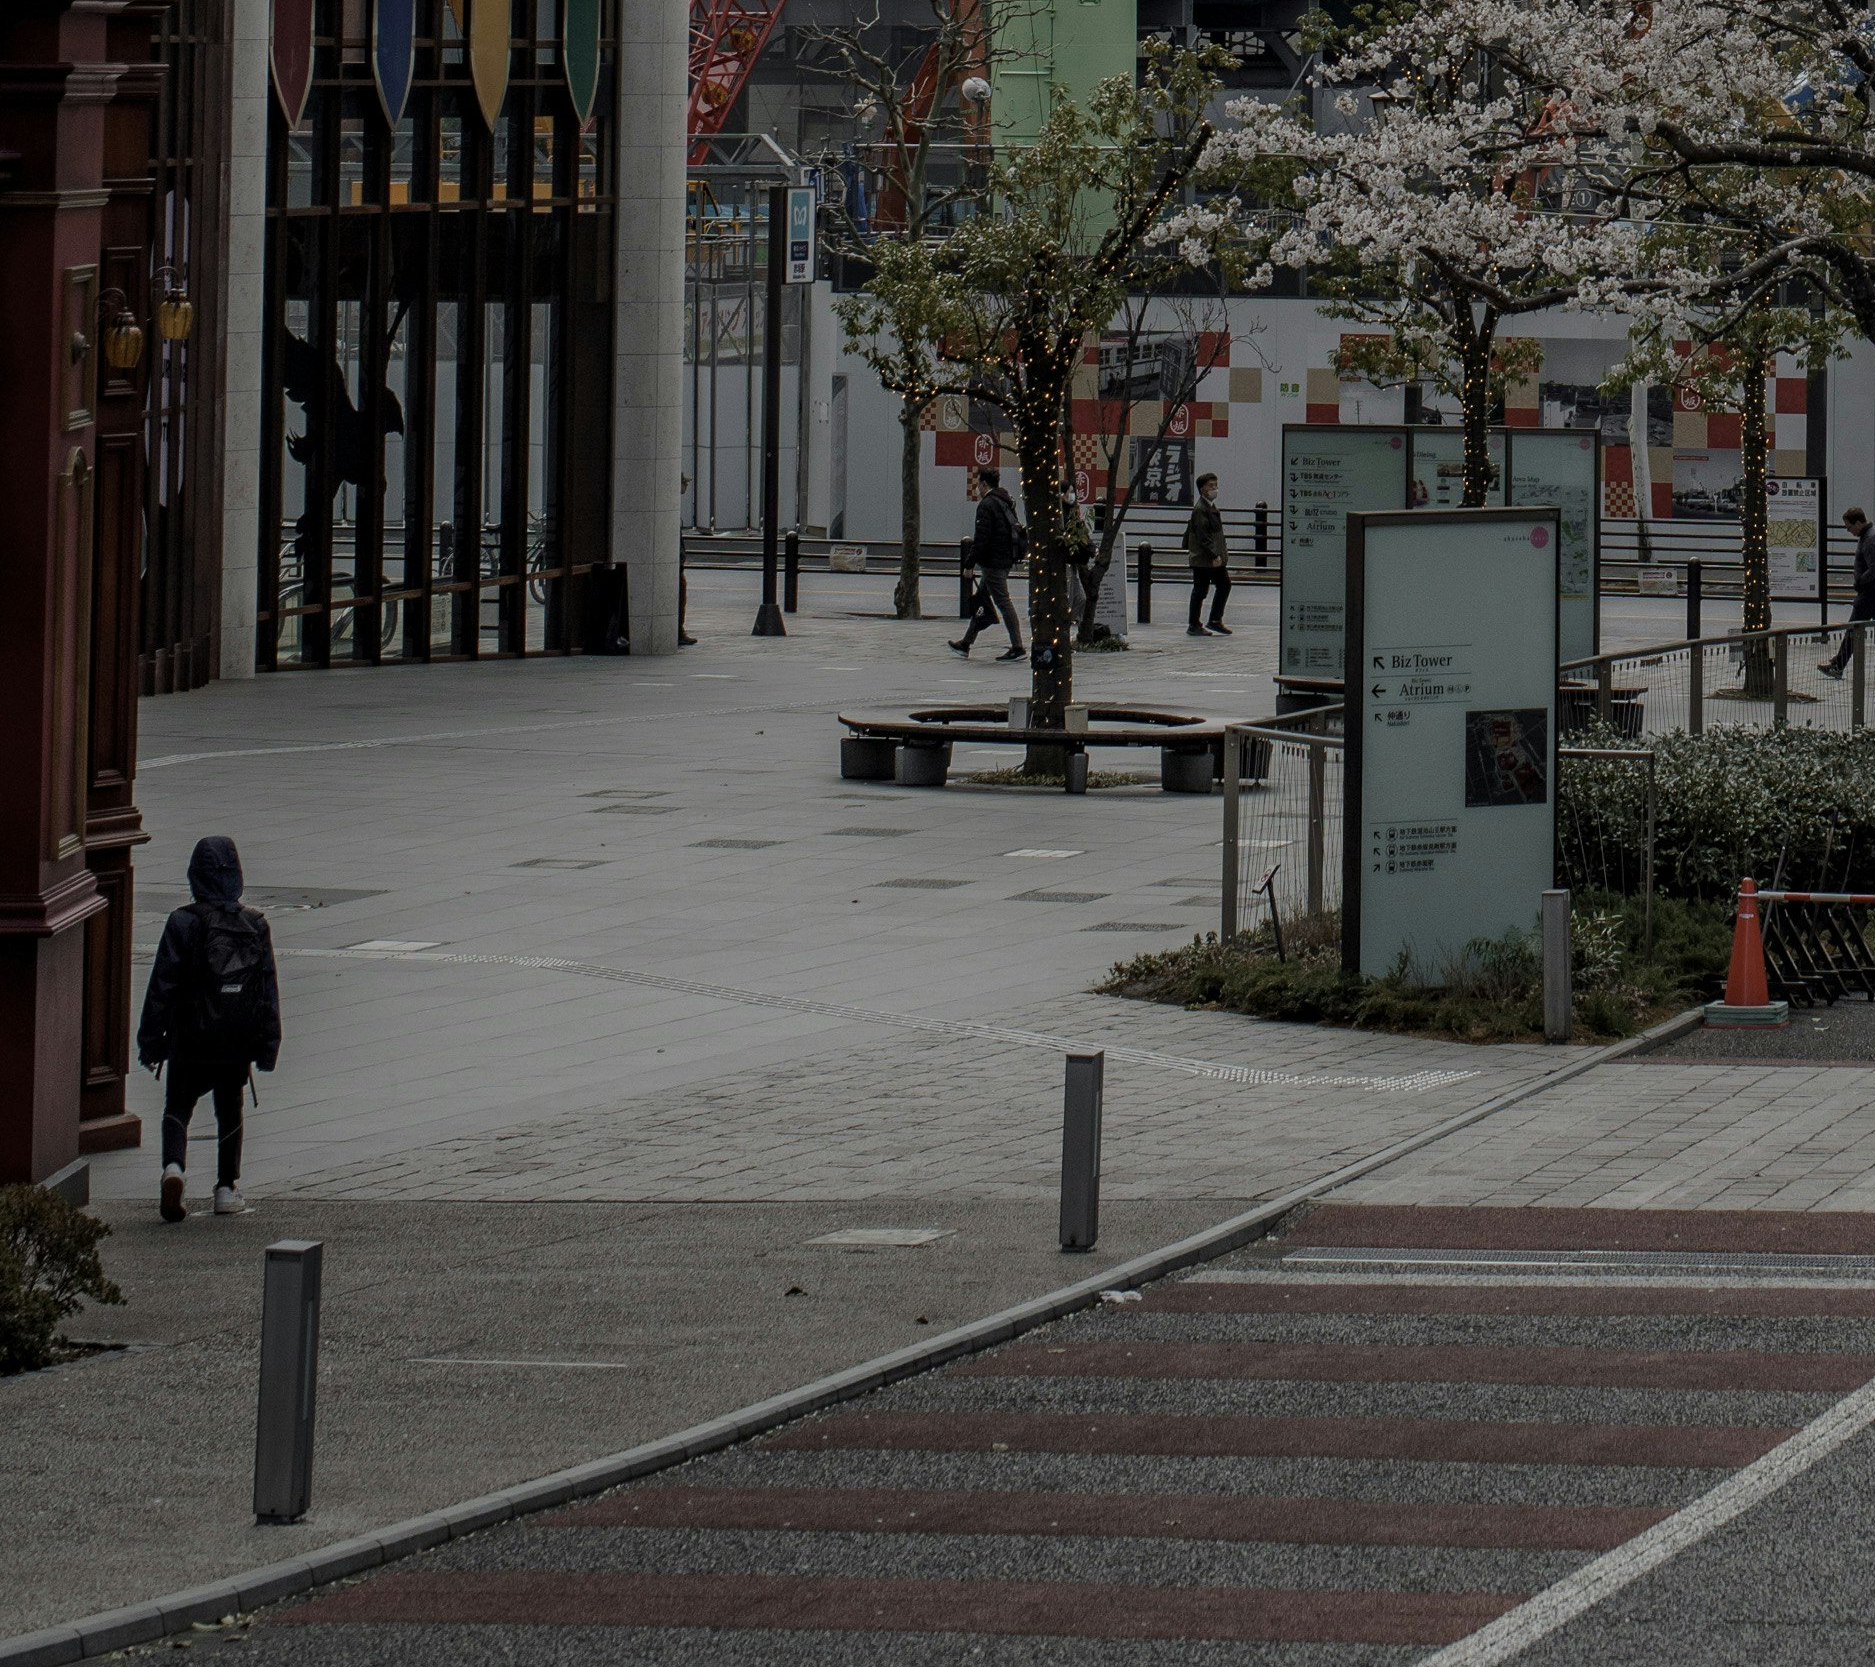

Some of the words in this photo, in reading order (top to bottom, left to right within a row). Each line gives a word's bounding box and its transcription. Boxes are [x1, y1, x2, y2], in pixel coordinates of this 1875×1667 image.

[1302, 457, 1316, 466] Biz
[1316, 457, 1341, 467] Tower
[1165, 444, 1183, 502] ラジオ
[1306, 522, 1336, 531] Atrium
[1391, 655, 1412, 669] Biz
[1412, 653, 1453, 668] Tower
[1399, 683, 1445, 697] Atrium
[1387, 710, 1411, 721] 仲通り
